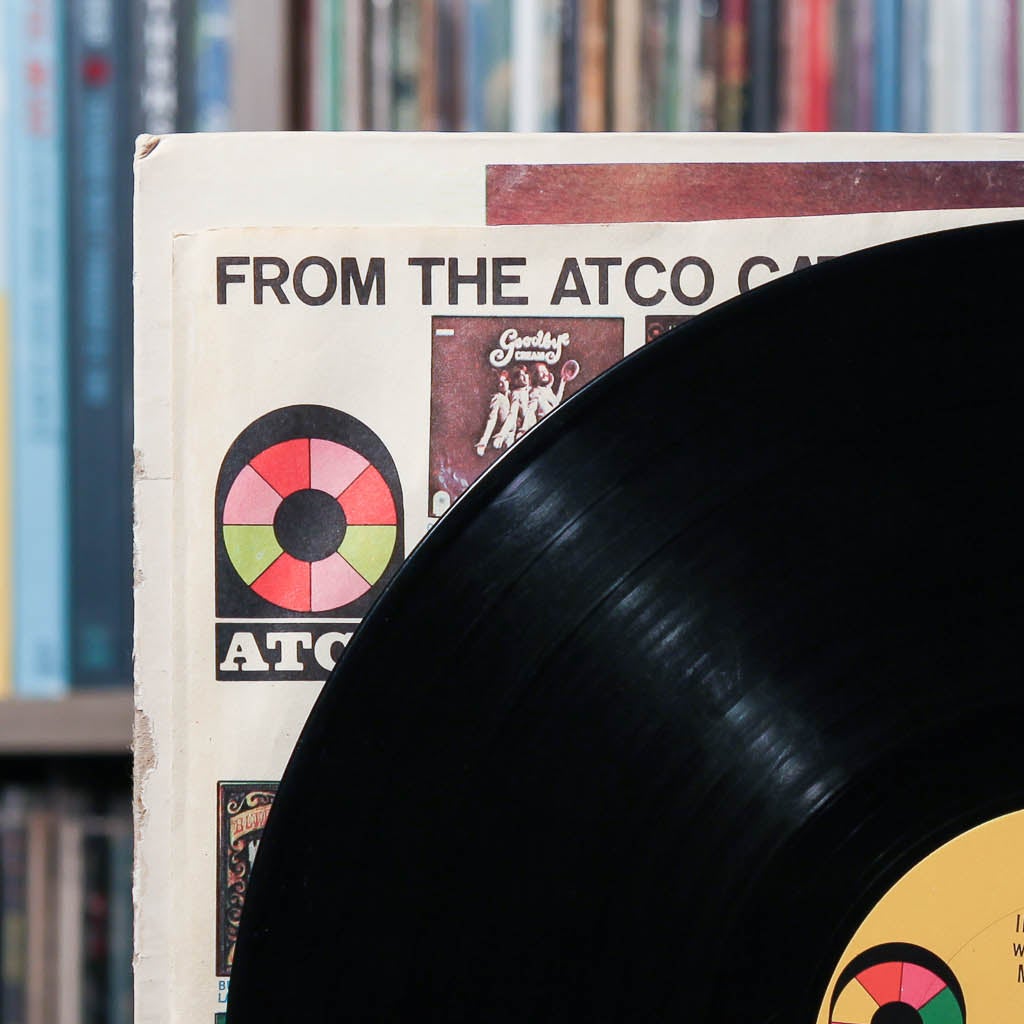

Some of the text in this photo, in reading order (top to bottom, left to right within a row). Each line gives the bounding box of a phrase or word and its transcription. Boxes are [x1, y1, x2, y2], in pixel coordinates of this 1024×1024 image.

[215, 256, 386, 306] FROM
[408, 256, 529, 306] THE
[550, 255, 715, 307] ATCO
[489, 328, 570, 367] Goodbye
